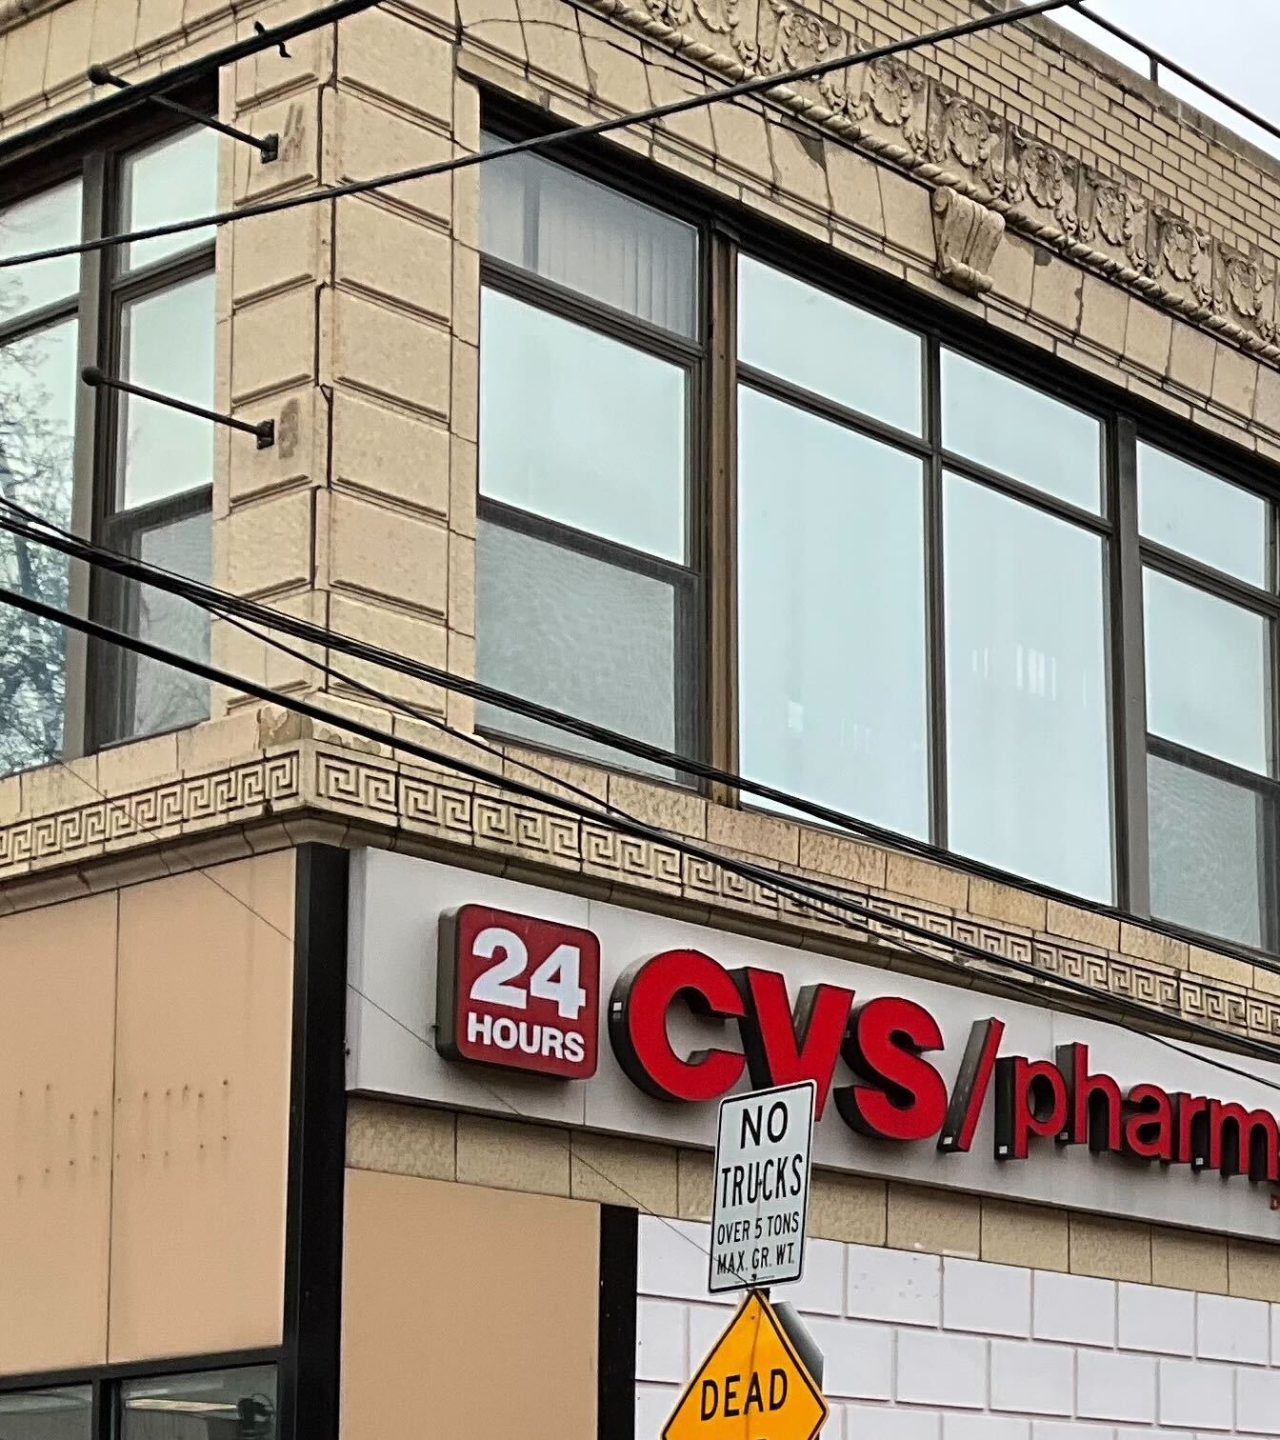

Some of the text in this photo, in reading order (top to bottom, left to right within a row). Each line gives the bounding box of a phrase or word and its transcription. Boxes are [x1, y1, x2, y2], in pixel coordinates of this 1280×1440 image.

[469, 927, 587, 1020] 24
[467, 1012, 586, 1063] HOURS
[740, 1101, 789, 1150] NO
[722, 1154, 803, 1209] TRUCKS
[717, 1211, 800, 1246] OVER 5 TONS
[700, 1368, 788, 1421] DEAD
